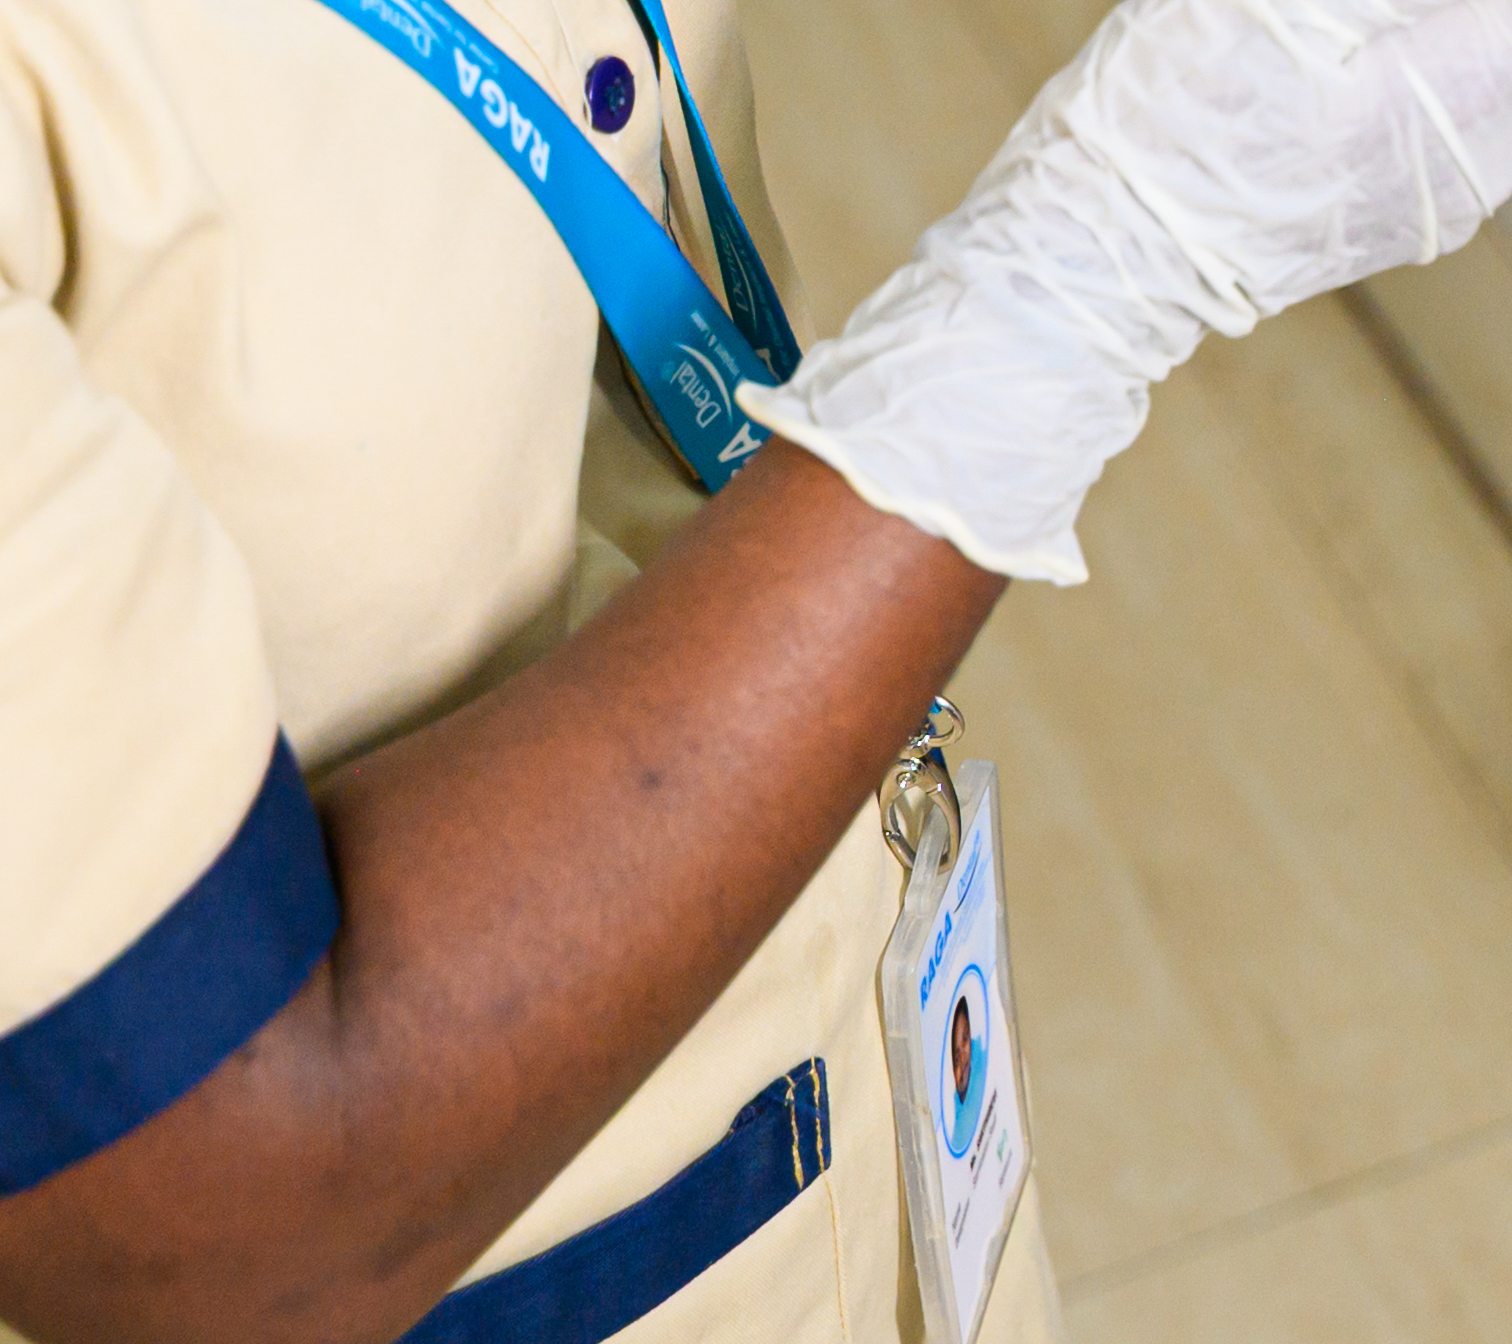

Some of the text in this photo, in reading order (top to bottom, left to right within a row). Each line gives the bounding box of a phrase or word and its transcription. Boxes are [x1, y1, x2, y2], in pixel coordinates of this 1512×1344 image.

[453, 46, 550, 183] RAGA
[670, 361, 721, 429] Dental
[920, 910, 953, 1012] RAGA
